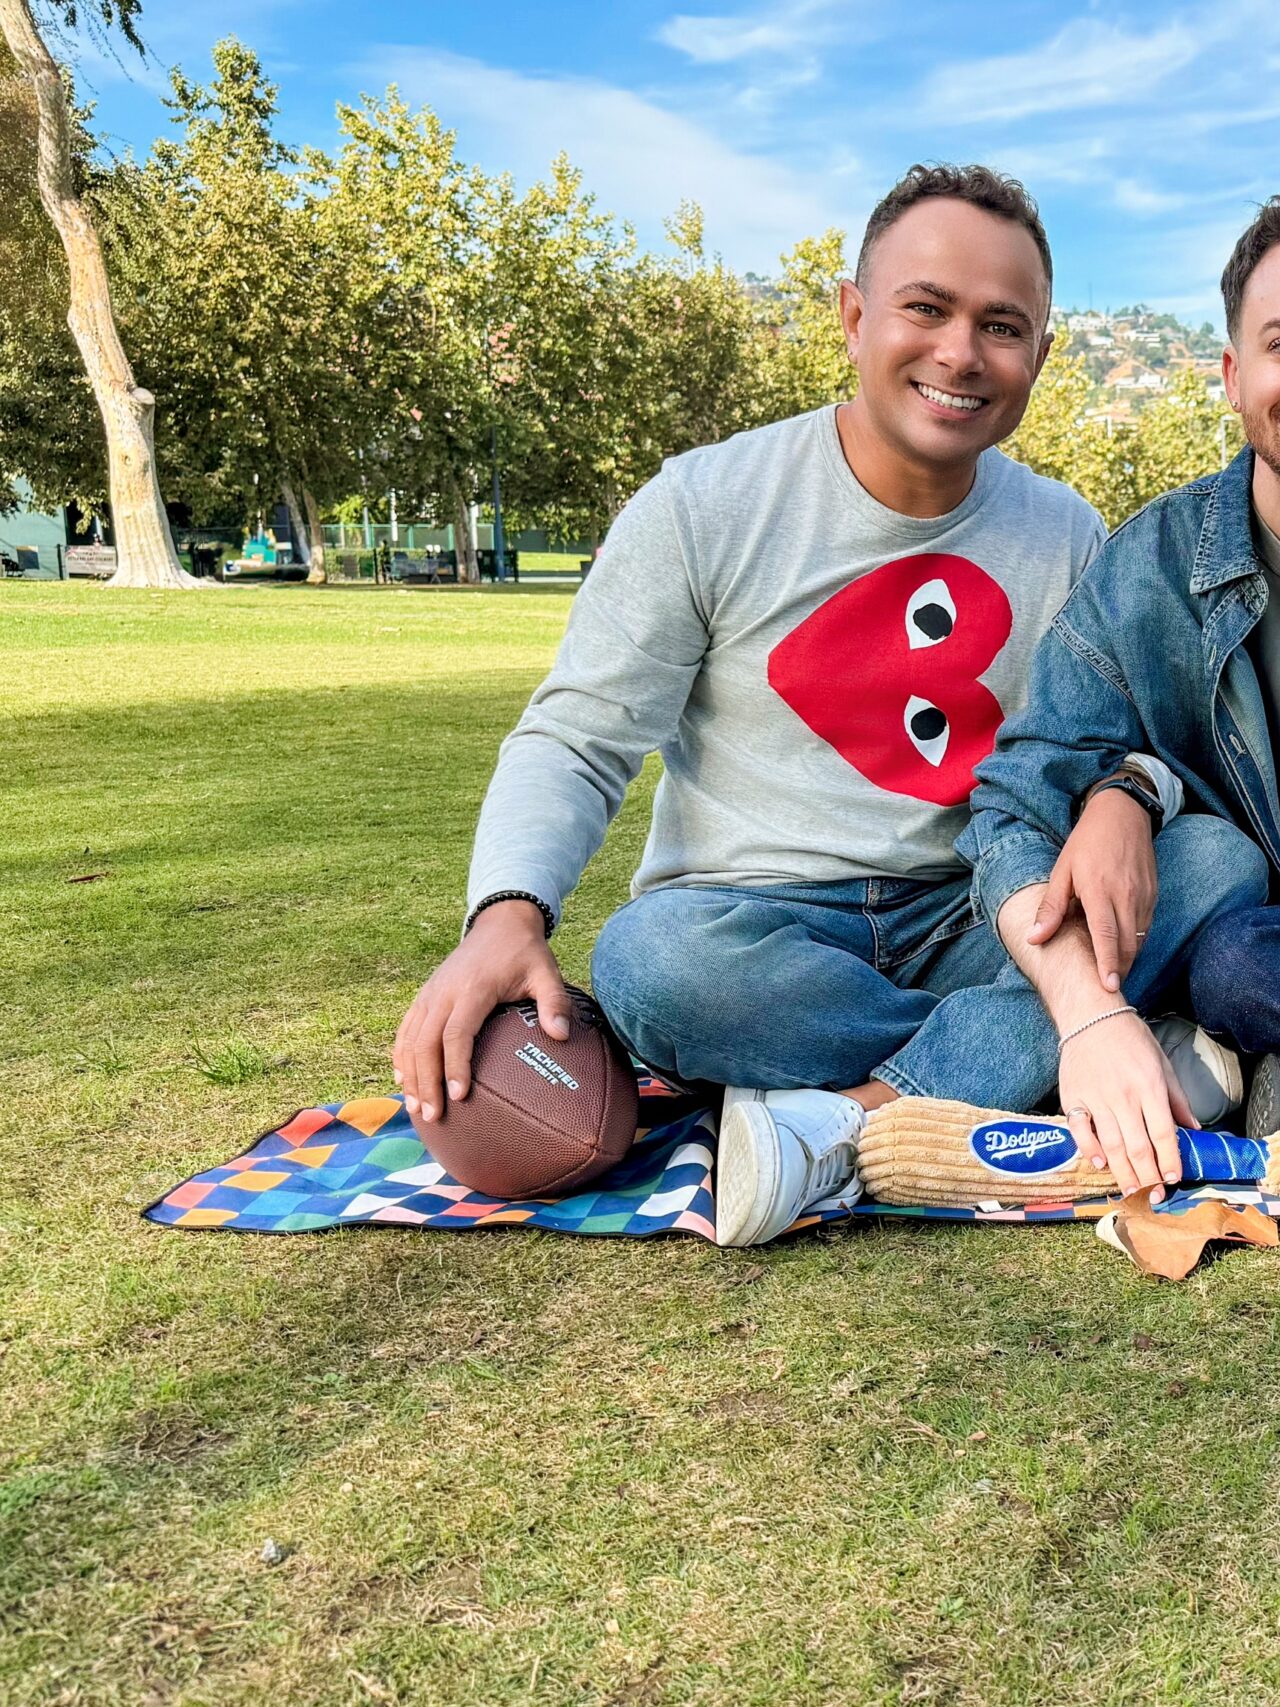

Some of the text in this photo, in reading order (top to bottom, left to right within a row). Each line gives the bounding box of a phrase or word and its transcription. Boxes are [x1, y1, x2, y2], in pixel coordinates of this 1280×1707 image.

[514, 1049, 560, 1086] COMPOSITE
[523, 1041, 580, 1091] TACKIFIED
[984, 1127, 1066, 1160] Dodgers
